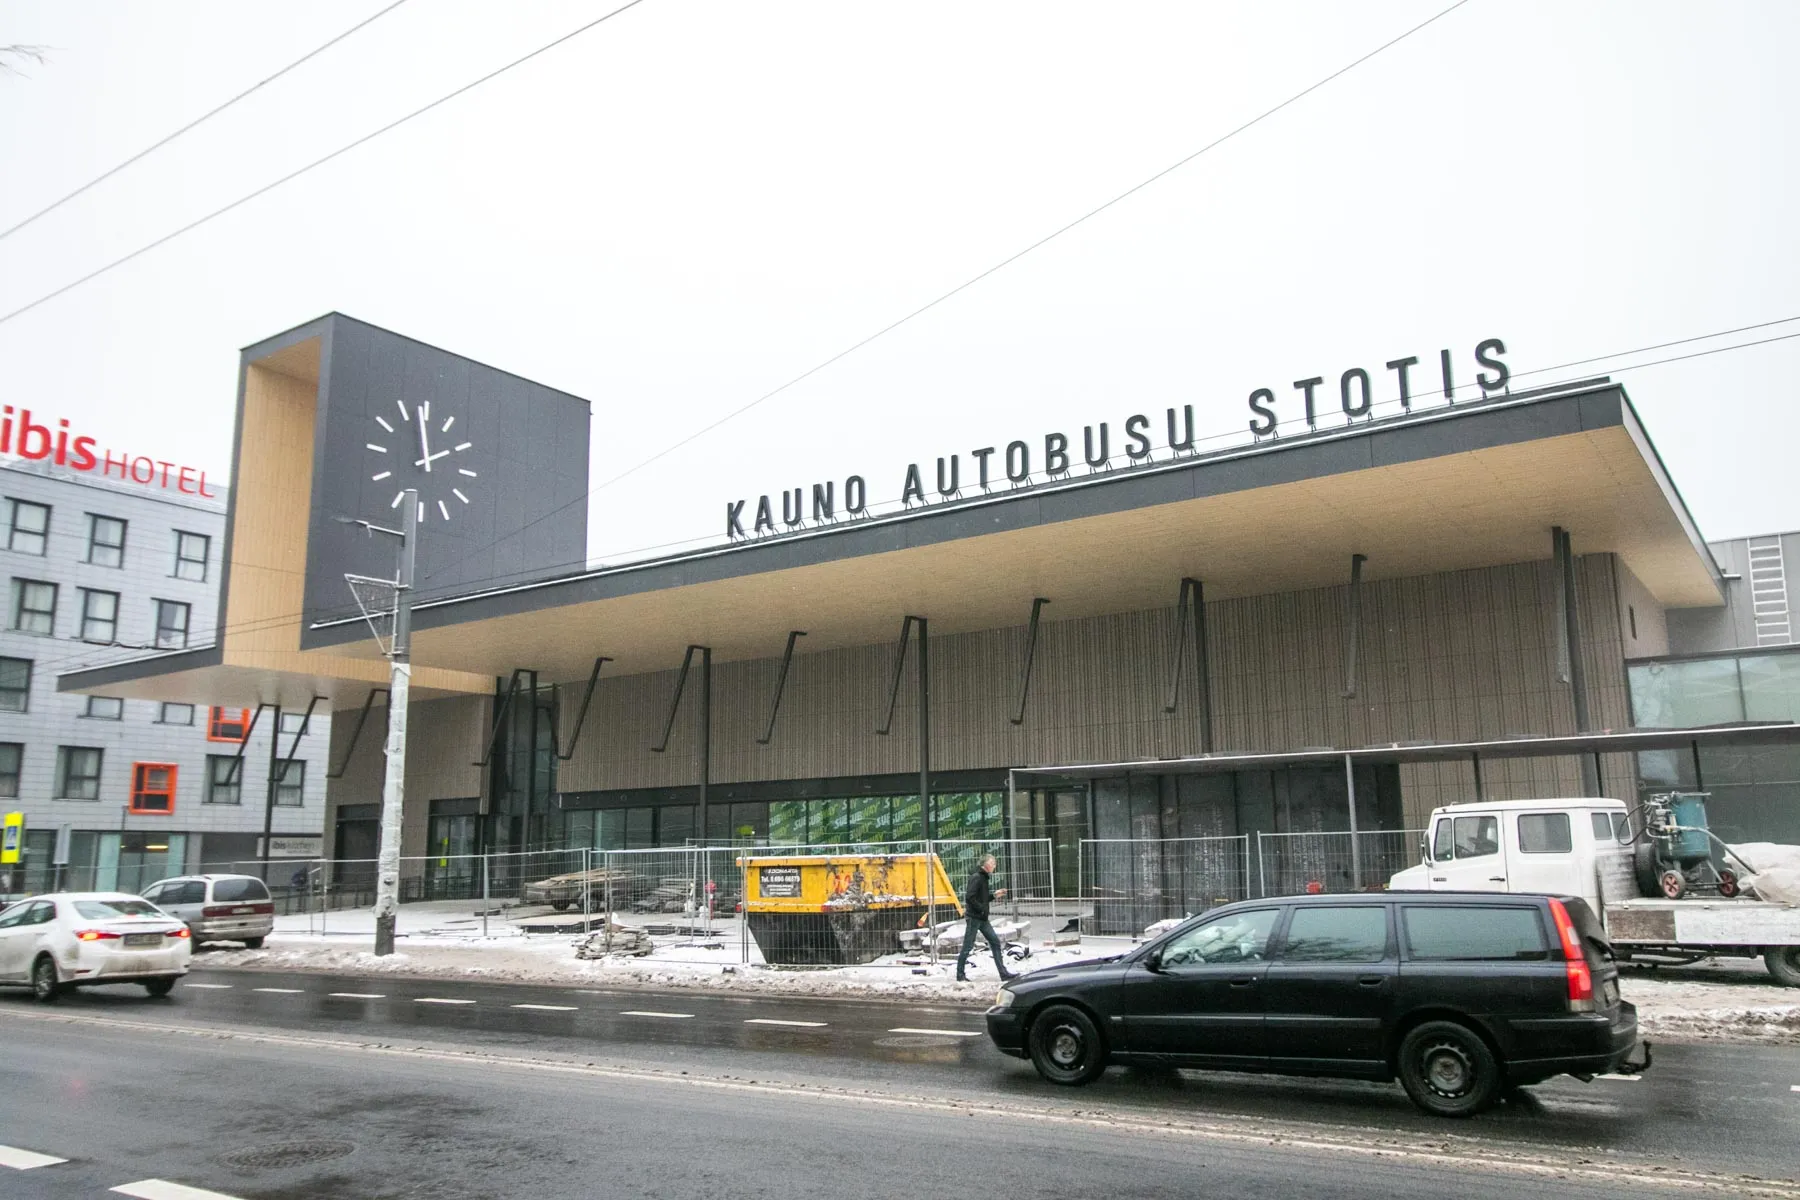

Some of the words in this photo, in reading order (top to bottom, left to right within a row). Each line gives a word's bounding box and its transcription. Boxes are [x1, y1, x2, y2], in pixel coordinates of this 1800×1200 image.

[0, 405, 97, 472] ibis
[104, 449, 215, 498] HOTEL
[727, 475, 866, 537] KAUNO
[902, 404, 1196, 504] AUTOBUSU
[1248, 338, 1510, 436] STOTIS
